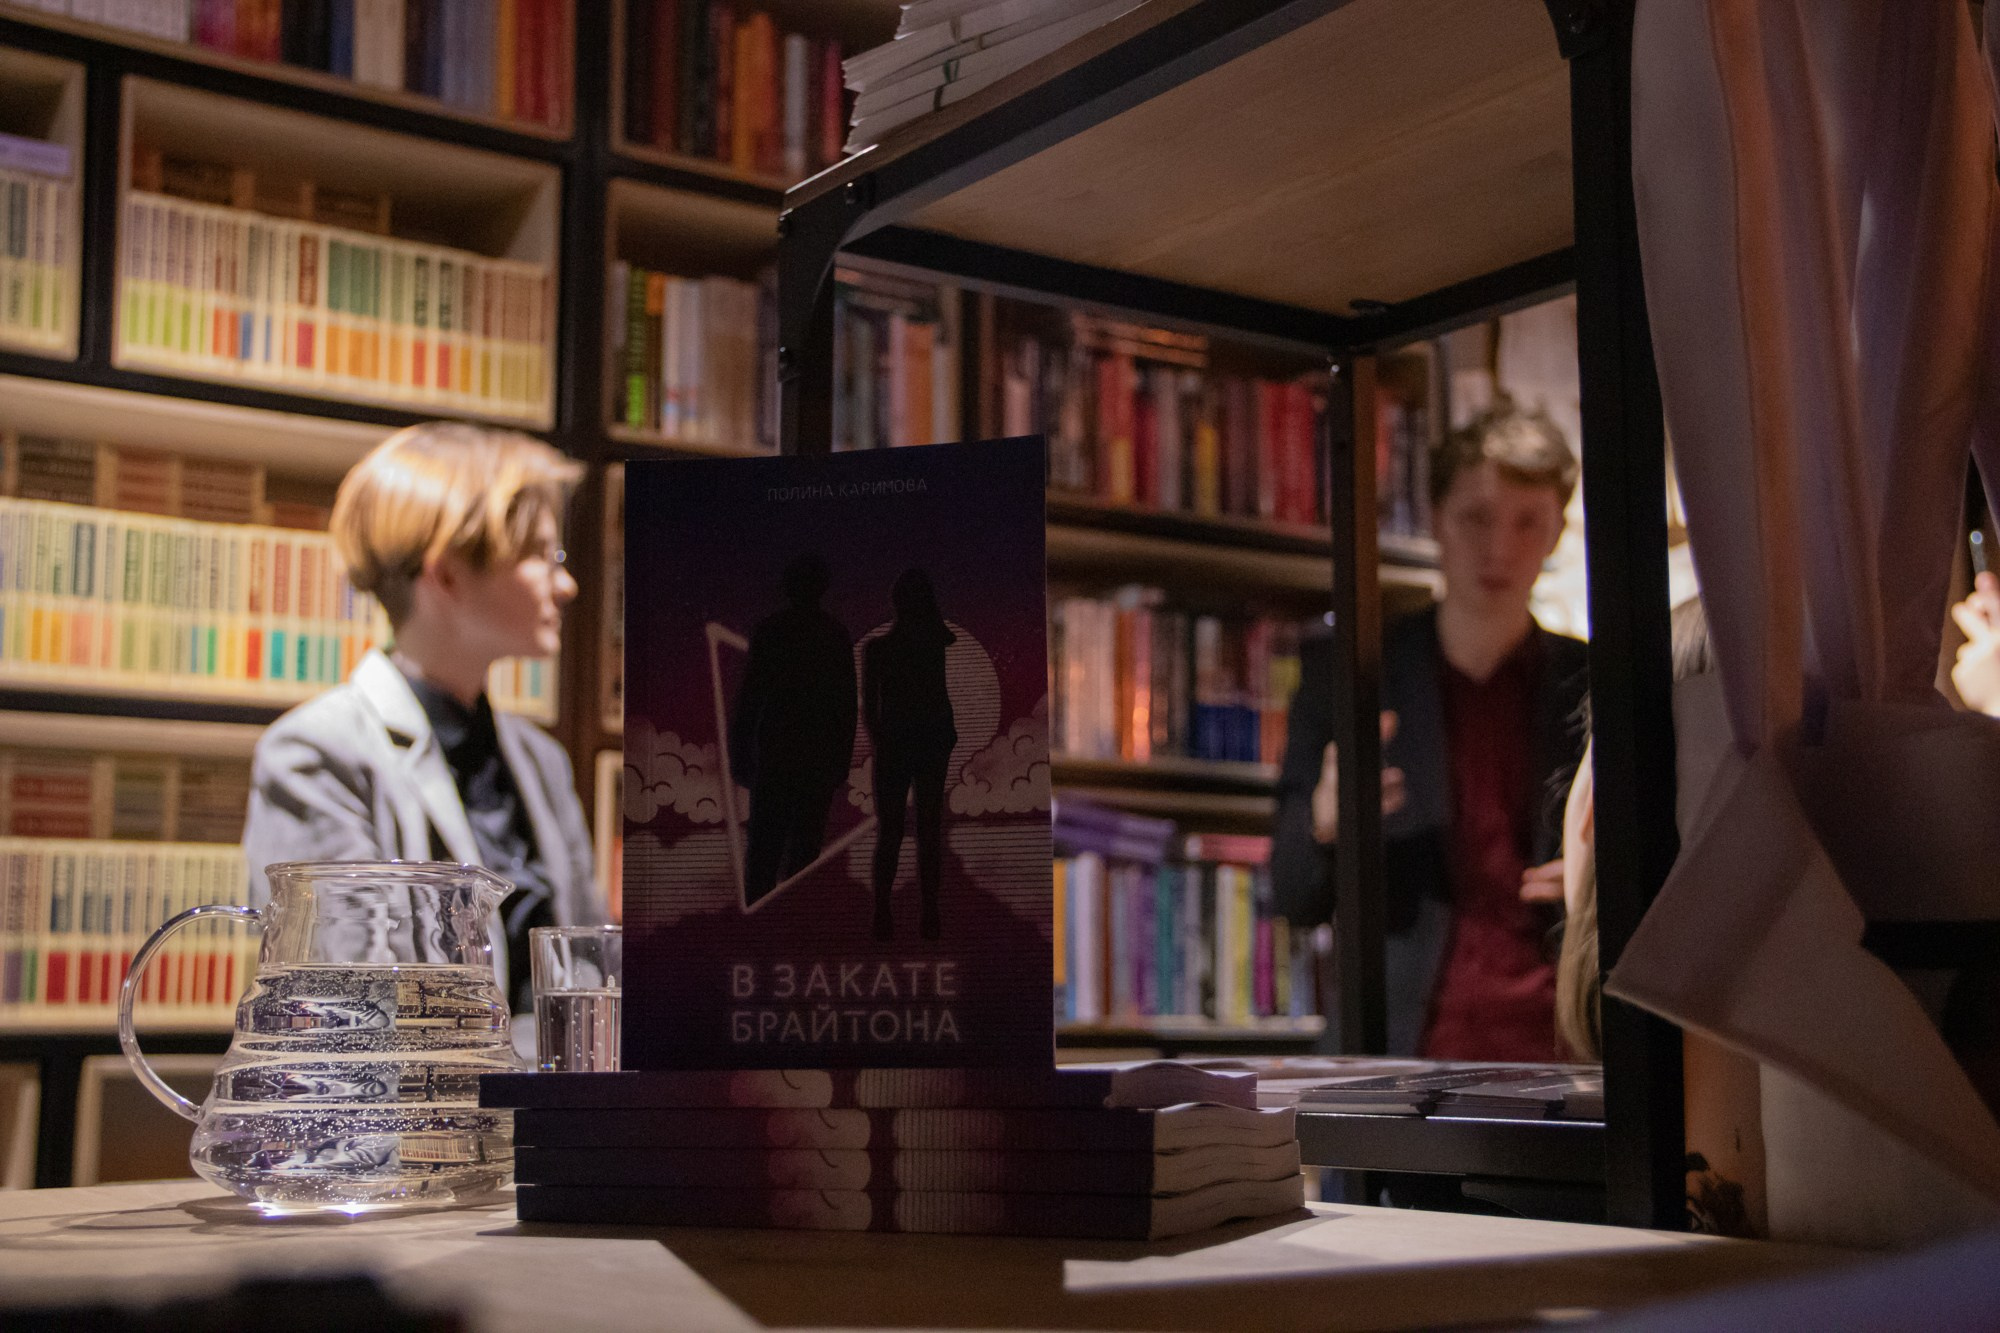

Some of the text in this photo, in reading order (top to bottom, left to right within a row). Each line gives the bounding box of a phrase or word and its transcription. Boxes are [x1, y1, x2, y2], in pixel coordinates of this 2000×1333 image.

[767, 478, 927, 502] ПОЛИНА КАРИМОВА
[732, 963, 956, 997] В ЗАКАТЕ
[732, 1003, 960, 1042] БРАЙТОНА
